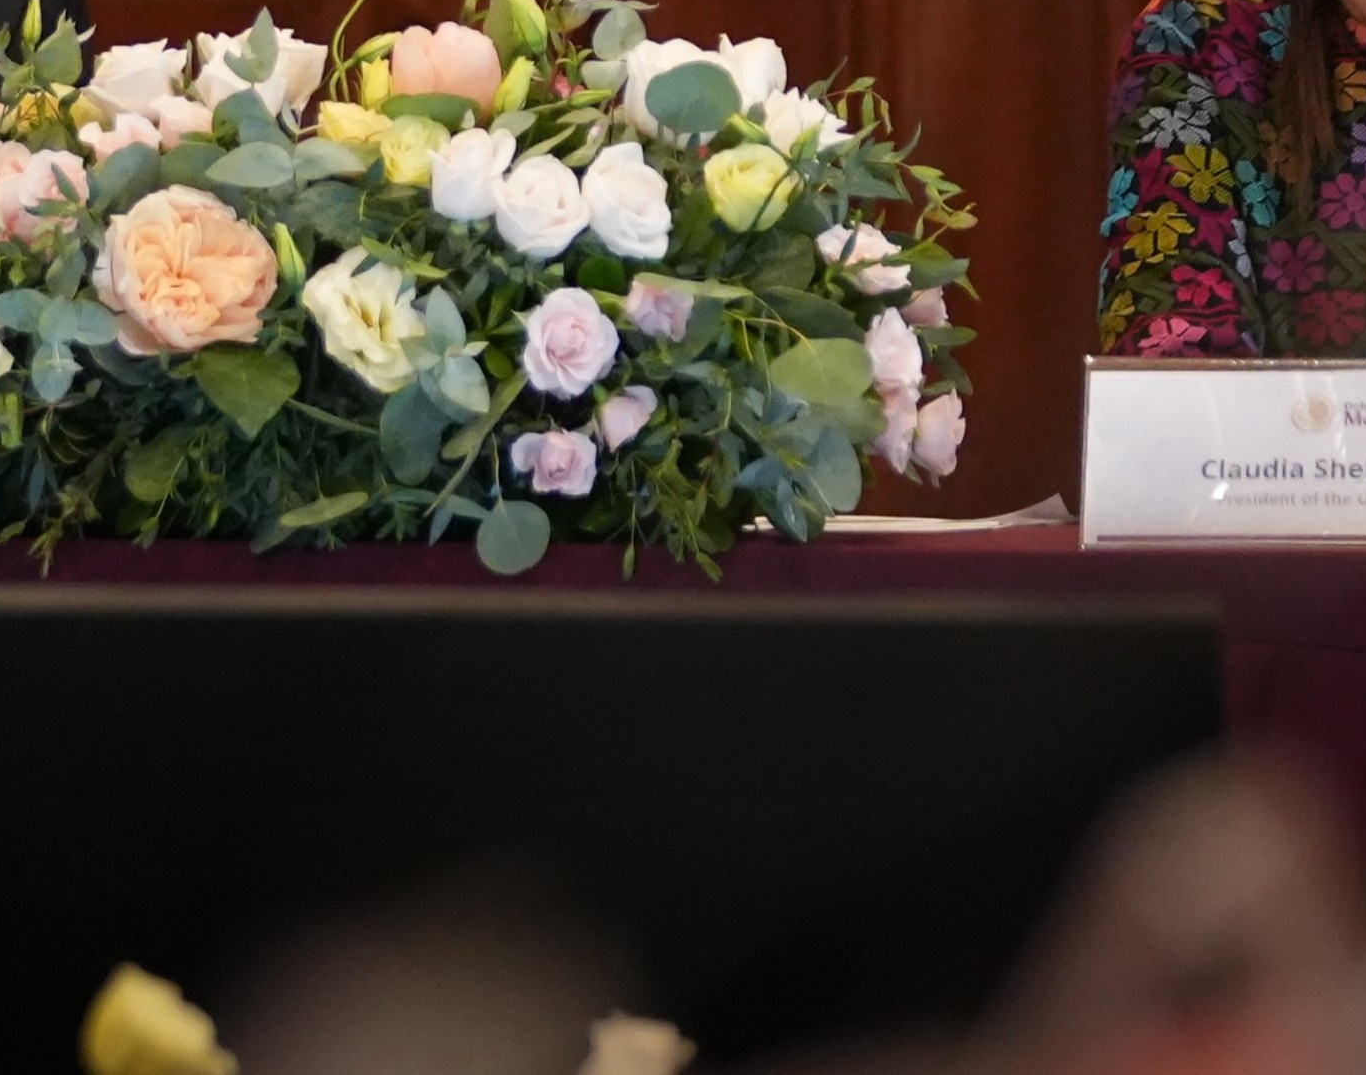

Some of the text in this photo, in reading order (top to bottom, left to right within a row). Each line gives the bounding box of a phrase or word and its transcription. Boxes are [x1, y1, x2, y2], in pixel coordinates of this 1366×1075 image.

[1201, 458, 1304, 480] Claudia
[1302, 492, 1318, 506] of
[1325, 492, 1352, 506] the
